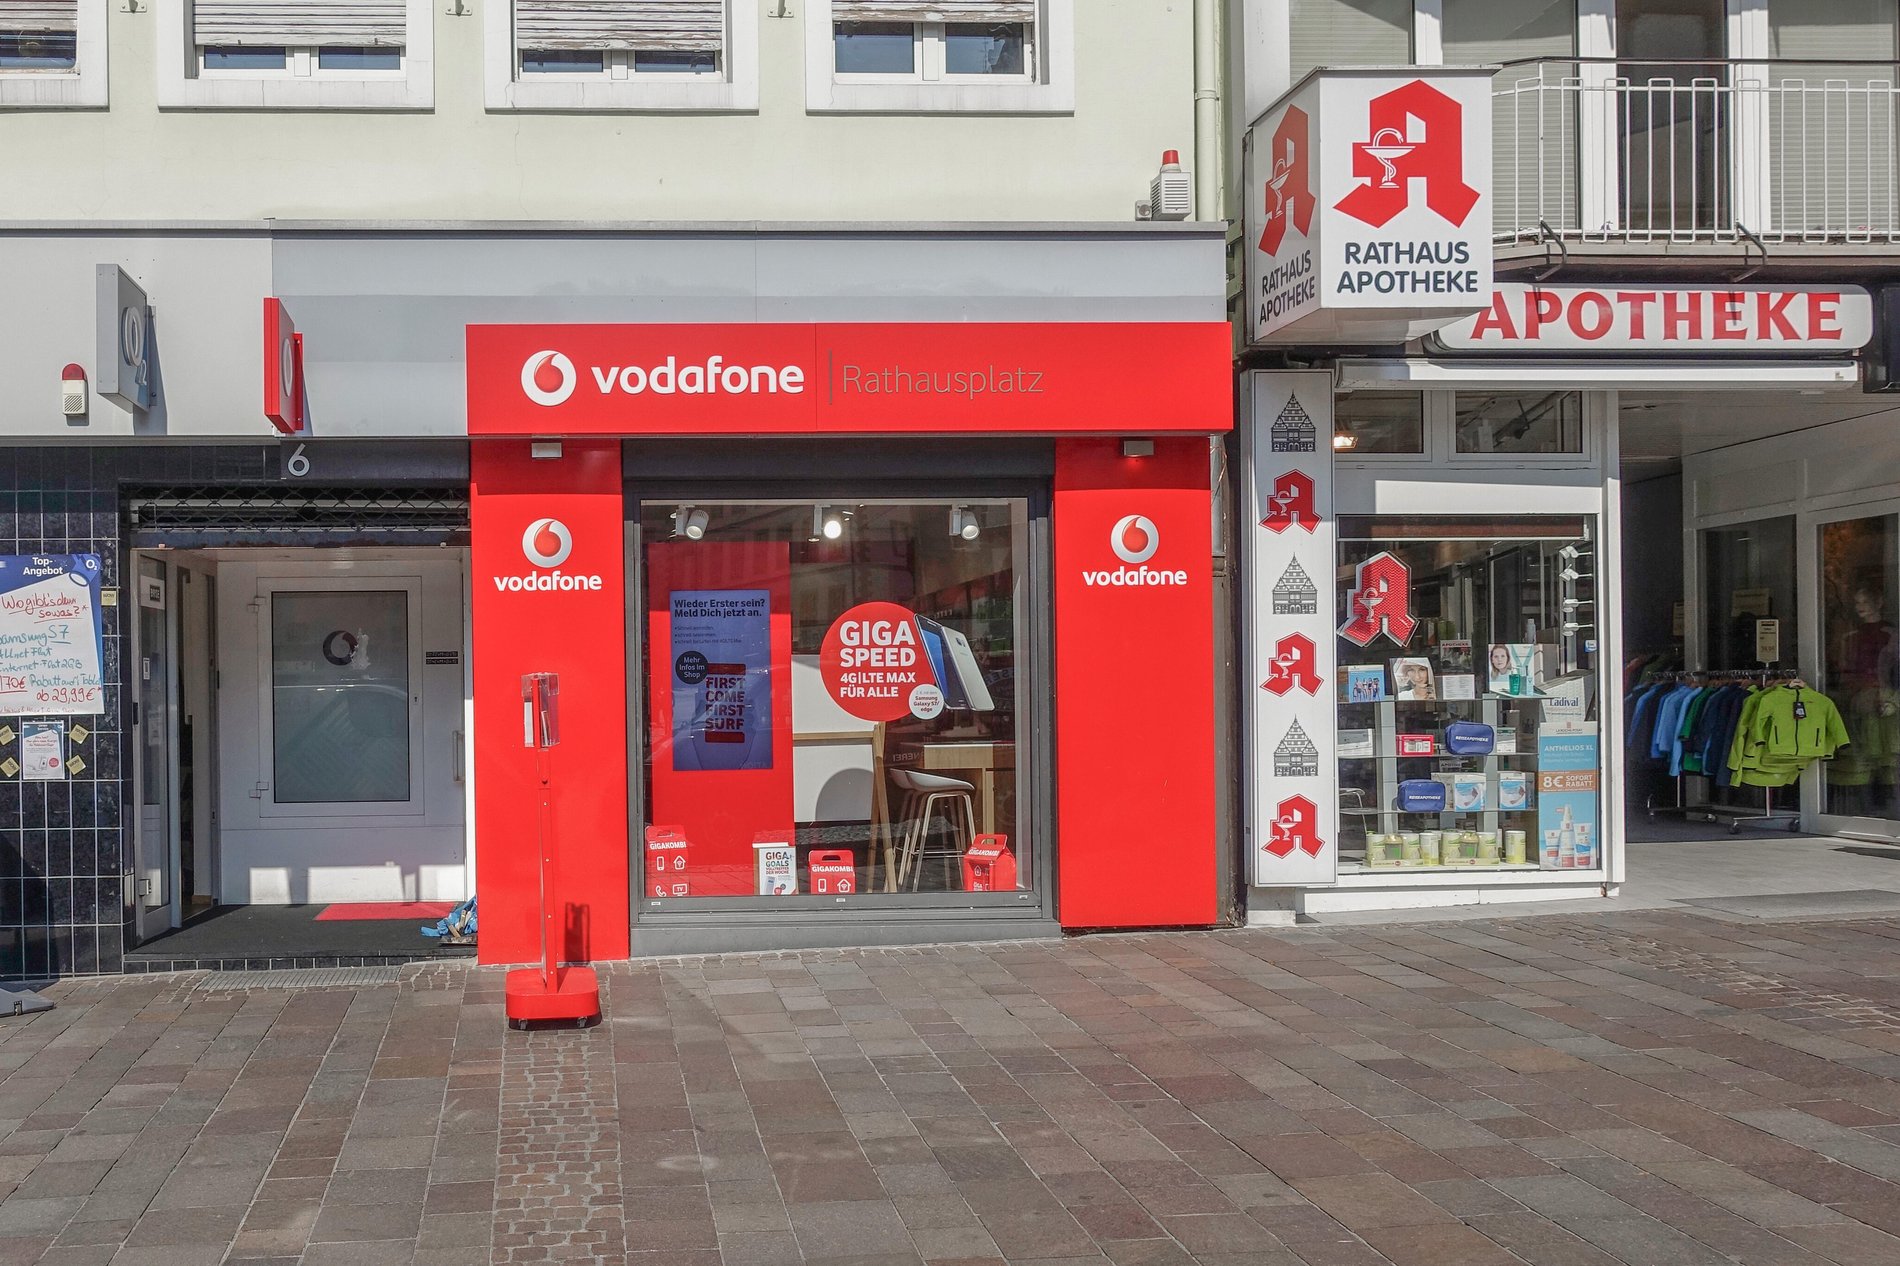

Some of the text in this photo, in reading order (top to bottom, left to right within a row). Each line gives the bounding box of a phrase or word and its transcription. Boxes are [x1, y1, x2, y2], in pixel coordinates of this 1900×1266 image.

[1345, 241, 1470, 265] RATHAUS
[1261, 250, 1312, 297] RATHAUS
[1337, 270, 1479, 293] APOTHEKE
[1259, 276, 1316, 325] APOTHEKE
[1469, 291, 1843, 341] APOTHEKE
[591, 355, 1044, 400] vodafone Rathausplatz
[287, 443, 310, 477] 6
[32, 557, 53, 567] Top-
[23, 566, 63, 577] Angebot
[1082, 565, 1187, 586] vodafone
[493, 570, 602, 592] vodafone
[674, 598, 765, 609] Wieder Erster sein?
[674, 608, 699, 617] Meld
[700, 608, 721, 617] Dich
[722, 608, 746, 618] jetzt
[48, 624, 69, 640] S7
[840, 620, 916, 646] GIGA
[683, 656, 701, 664] Mehr
[840, 647, 916, 668] SPEED
[705, 677, 745, 689] FIRST
[886, 672, 916, 683] MAX
[36, 688, 49, 702] ab
[705, 690, 745, 702] COME
[840, 684, 899, 698] FÜR ALLE
[1549, 696, 1579, 707] Ladival
[705, 704, 745, 716] FIRST
[705, 718, 744, 730] SURF
[1544, 744, 1585, 752] ANTHELIOS
[1543, 776, 1564, 788] 8€
[650, 841, 687, 850] GIGAKOMBI
[765, 851, 790, 861] GIGA
[765, 860, 789, 868] GOALS
